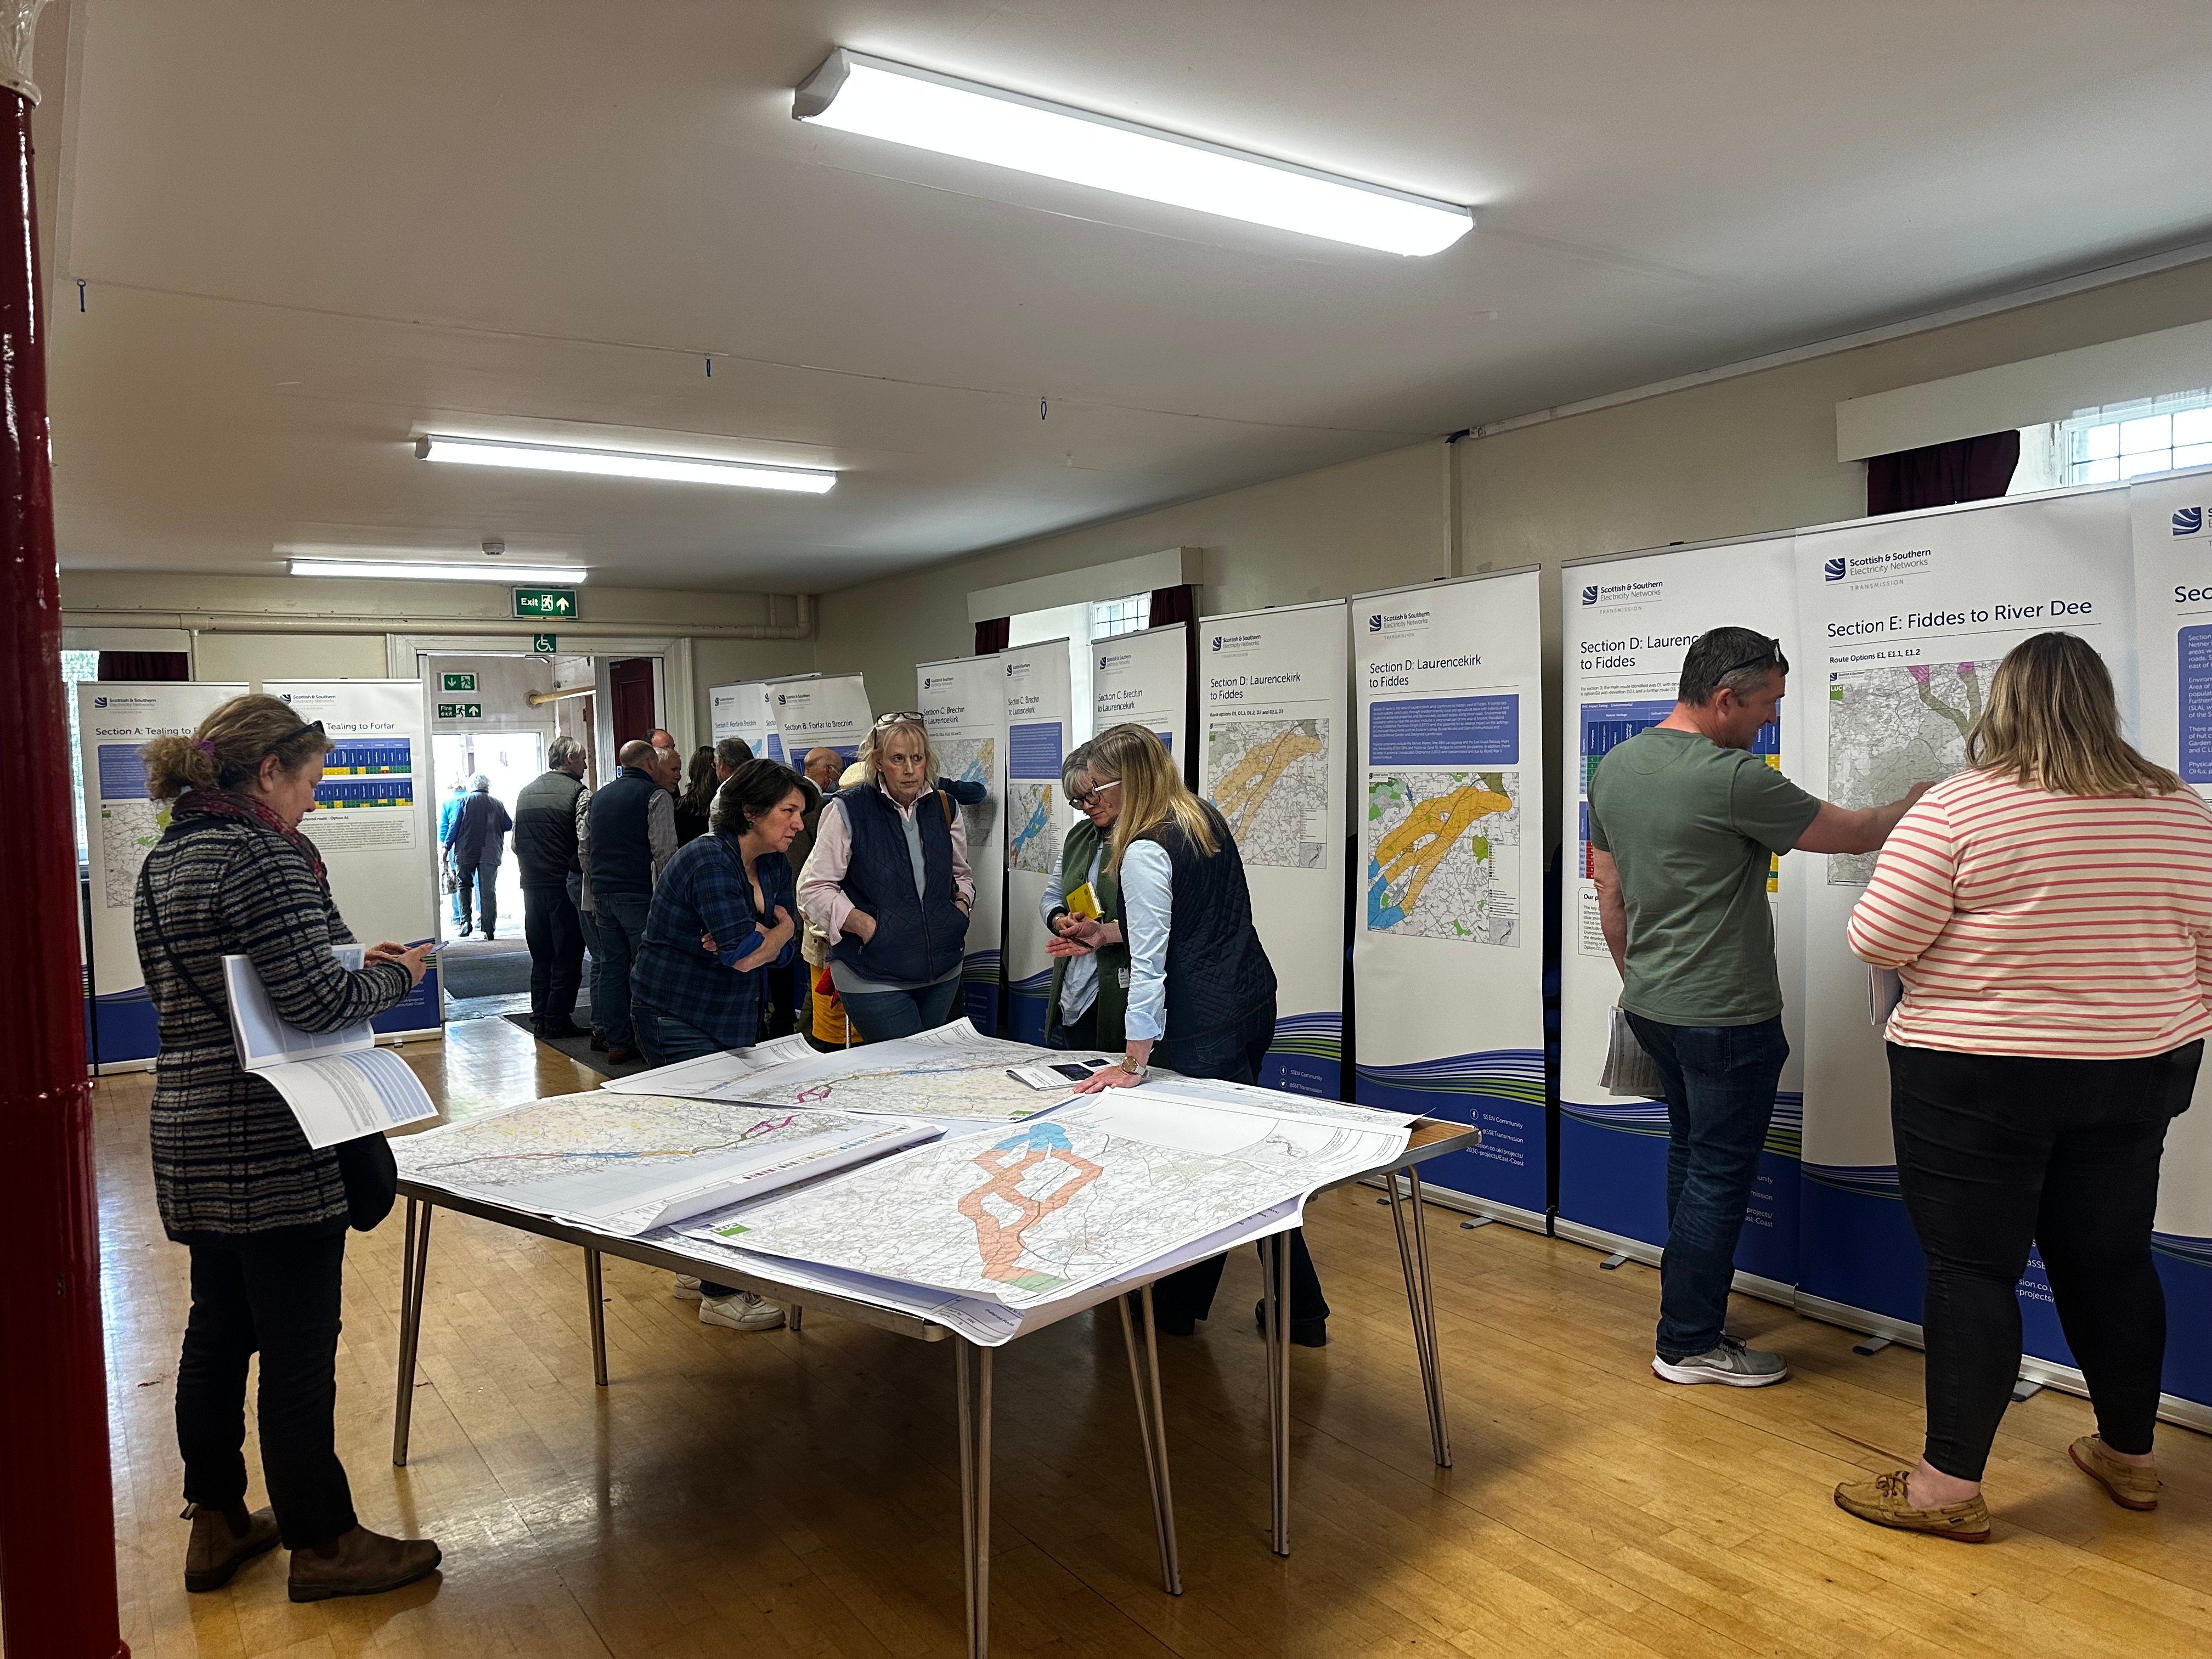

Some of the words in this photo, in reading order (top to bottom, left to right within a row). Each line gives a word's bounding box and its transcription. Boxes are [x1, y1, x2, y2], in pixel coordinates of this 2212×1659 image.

[1850, 555, 1883, 567] Scottish
[1893, 549, 1931, 561] Southern
[1850, 565, 1888, 575] Electricity
[1890, 559, 1928, 570] Networks
[1601, 585, 1626, 594] Scottish
[1633, 582, 1663, 590] Southern
[1850, 579, 1904, 591] TRANSMISSION
[1600, 592, 1629, 601] Electricity
[1632, 589, 1661, 597] Networks
[2175, 586, 2212, 602] Sec
[521, 598, 538, 607] Exit
[1600, 606, 1642, 614] TRANSMISSION
[1827, 620, 1884, 637] Section
[1889, 616, 1902, 630] E:
[1908, 611, 1965, 629] Fiddes
[1971, 609, 1988, 623] to
[1995, 604, 2044, 620] River
[2051, 600, 2092, 616] Dee
[1581, 640, 1625, 653] Section
[1630, 637, 1643, 650] D:
[1647, 635, 1700, 648] Laurenc
[1370, 662, 1402, 674] Section
[1405, 660, 1414, 670] D:
[1417, 654, 1481, 669] Laurencekirk
[1581, 659, 1592, 670] to
[1596, 656, 1635, 669] Fiddes
[1850, 654, 1875, 662] Options
[1211, 678, 1237, 688] Section
[1240, 676, 1248, 686] D:
[1250, 672, 1301, 685] Laurencekirk
[1370, 679, 1378, 688] to
[1381, 675, 1409, 687] Fiddes
[1098, 692, 1115, 702] Section
[1124, 689, 1142, 698] Brechin
[1210, 692, 1217, 700] to
[1219, 690, 1243, 699] Fiddes
[923, 708, 939, 716] Section
[1013, 707, 1035, 715] Laurencekirk
[1103, 701, 1135, 712] Laurencekirk
[928, 716, 958, 725] Laurencekirk
[145, 727, 179, 736] Tealing
[326, 723, 357, 731] Tealing
[1301, 1072, 1322, 1082] Community
[1496, 1116, 1523, 1129] Community
[1482, 1129, 1523, 1143] @SSETransmission
[1466, 1147, 1524, 1166] 2030-projects/East-Coast
[1757, 1175, 1773, 1184] unity
[713, 1223, 739, 1233] LUC
[1745, 1216, 1773, 1228] ast-Coast
[2016, 1289, 2054, 1303] -projects/
